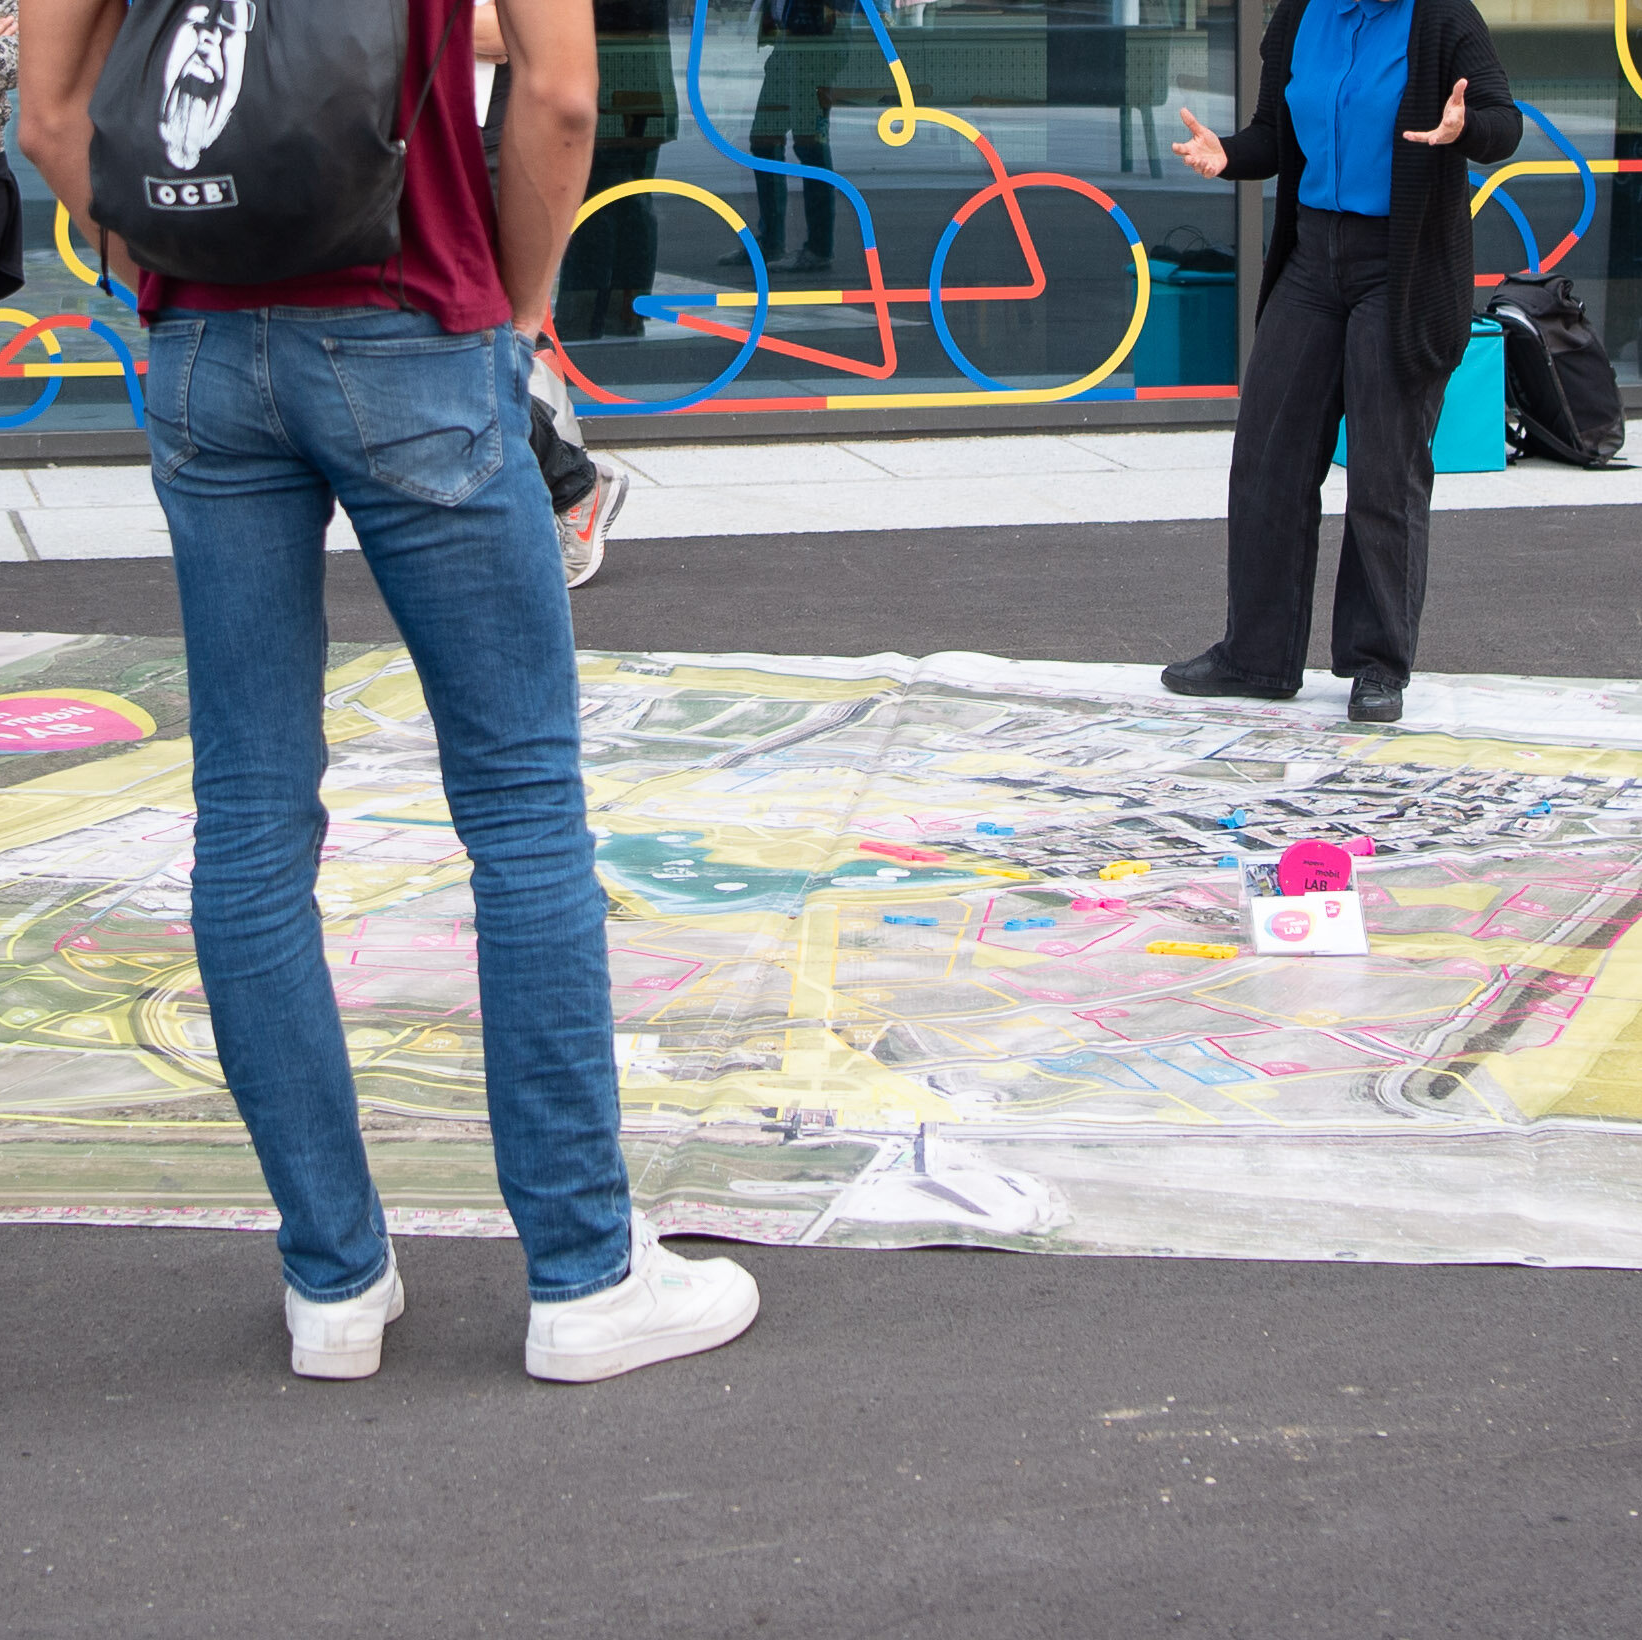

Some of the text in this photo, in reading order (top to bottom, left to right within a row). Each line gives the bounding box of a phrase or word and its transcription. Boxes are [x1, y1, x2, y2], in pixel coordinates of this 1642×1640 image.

[157, 183, 225, 205] OCB
[0, 706, 96, 728] mobil
[1314, 869, 1340, 879] mobil
[1304, 878, 1328, 892] LAB
